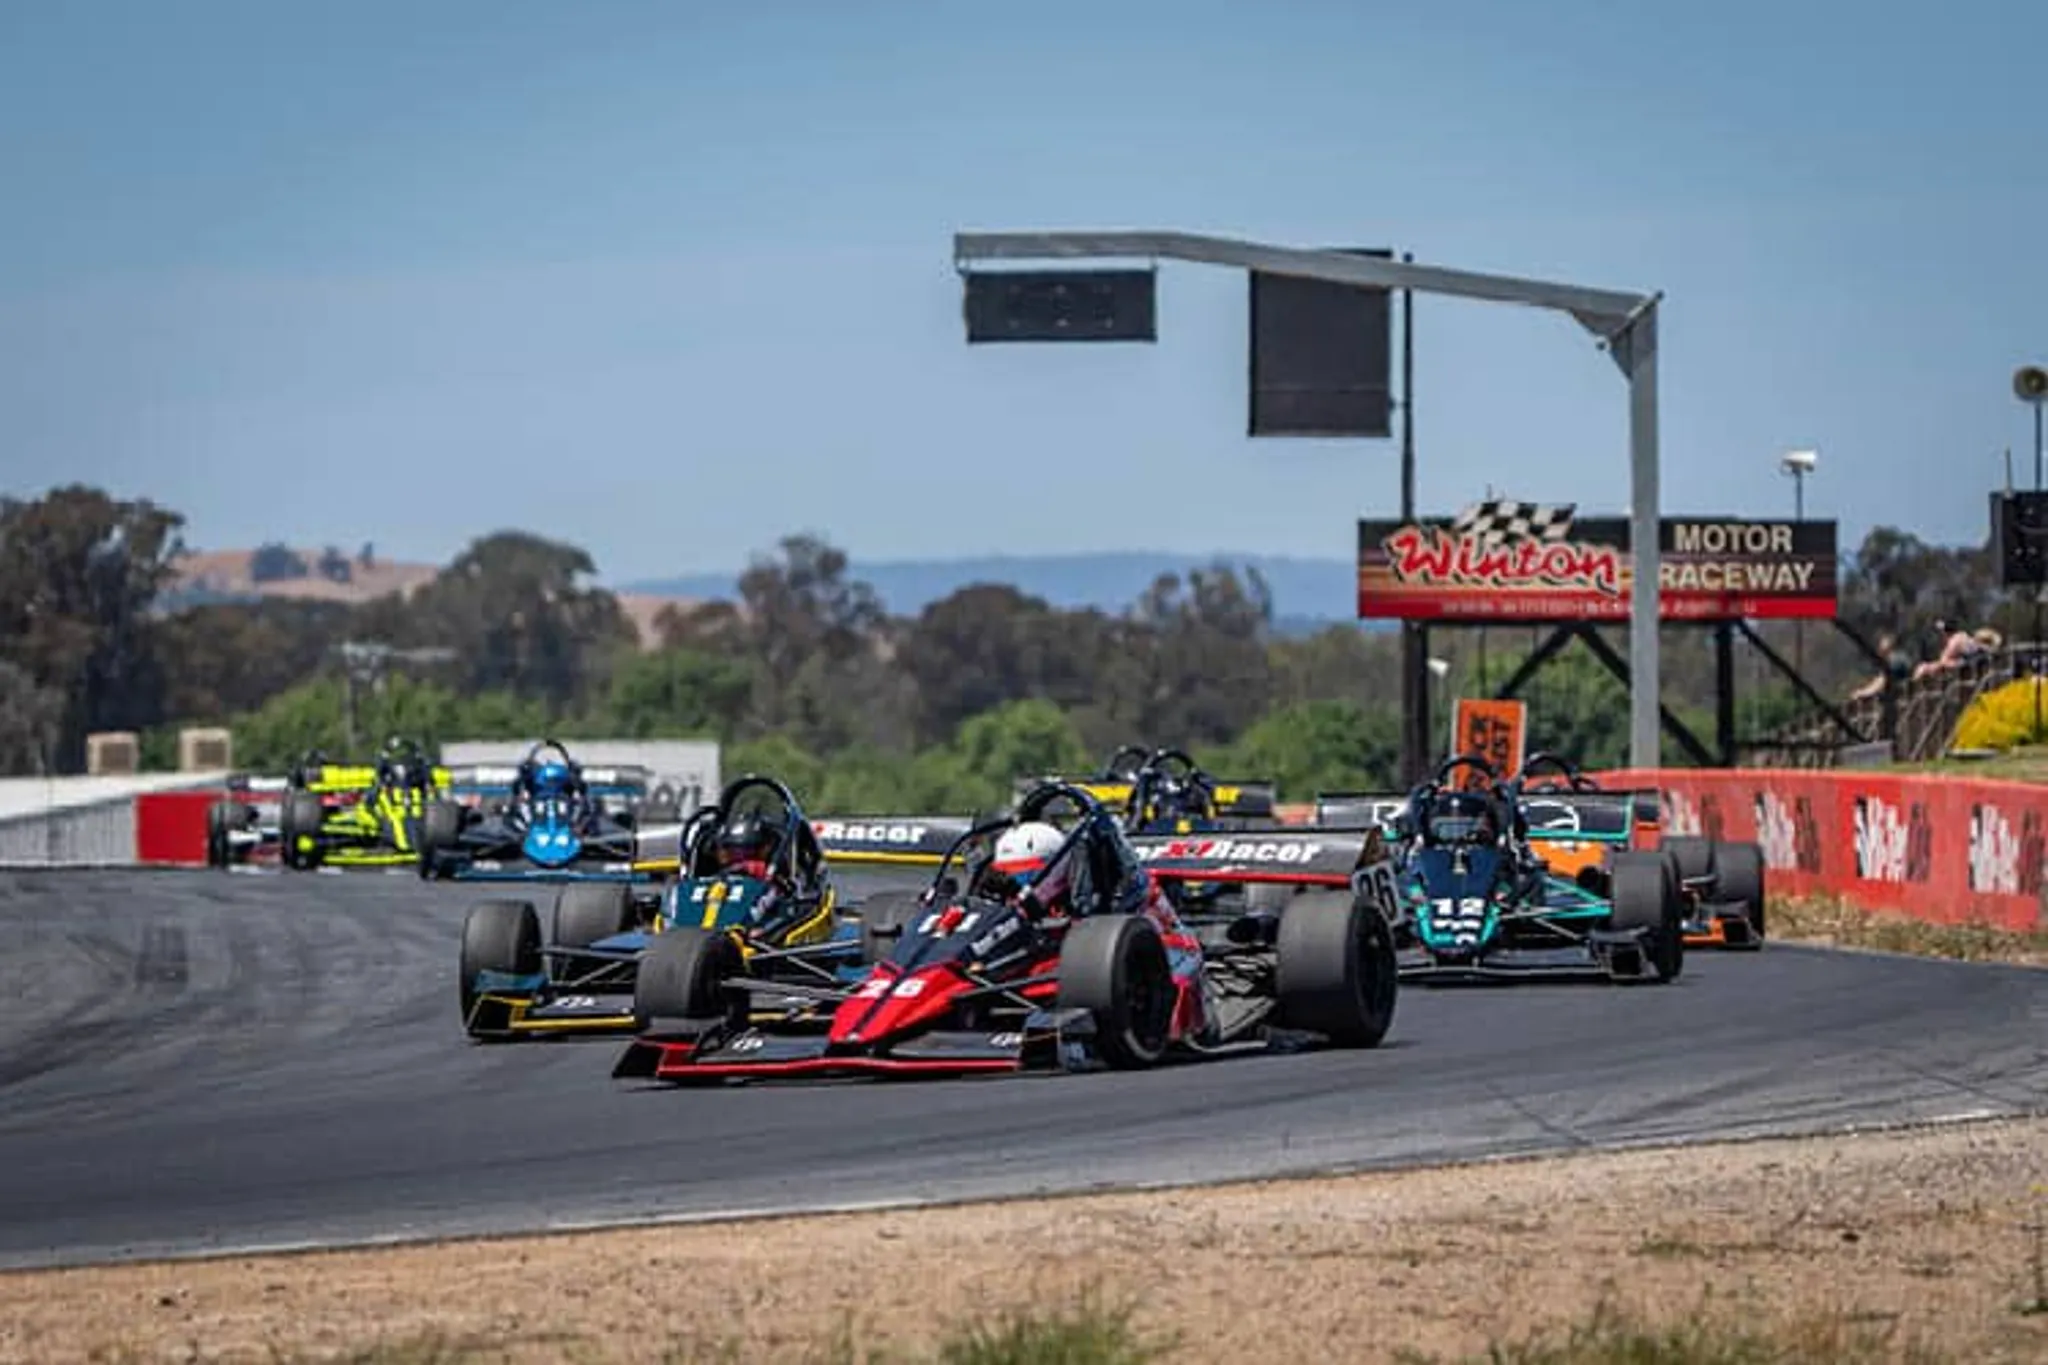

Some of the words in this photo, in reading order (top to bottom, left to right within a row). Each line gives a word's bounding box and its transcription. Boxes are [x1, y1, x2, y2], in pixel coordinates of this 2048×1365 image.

[1674, 524, 1793, 552] MOTOR
[1388, 526, 1620, 594] Winton
[1659, 562, 1815, 591] RACEWAY
